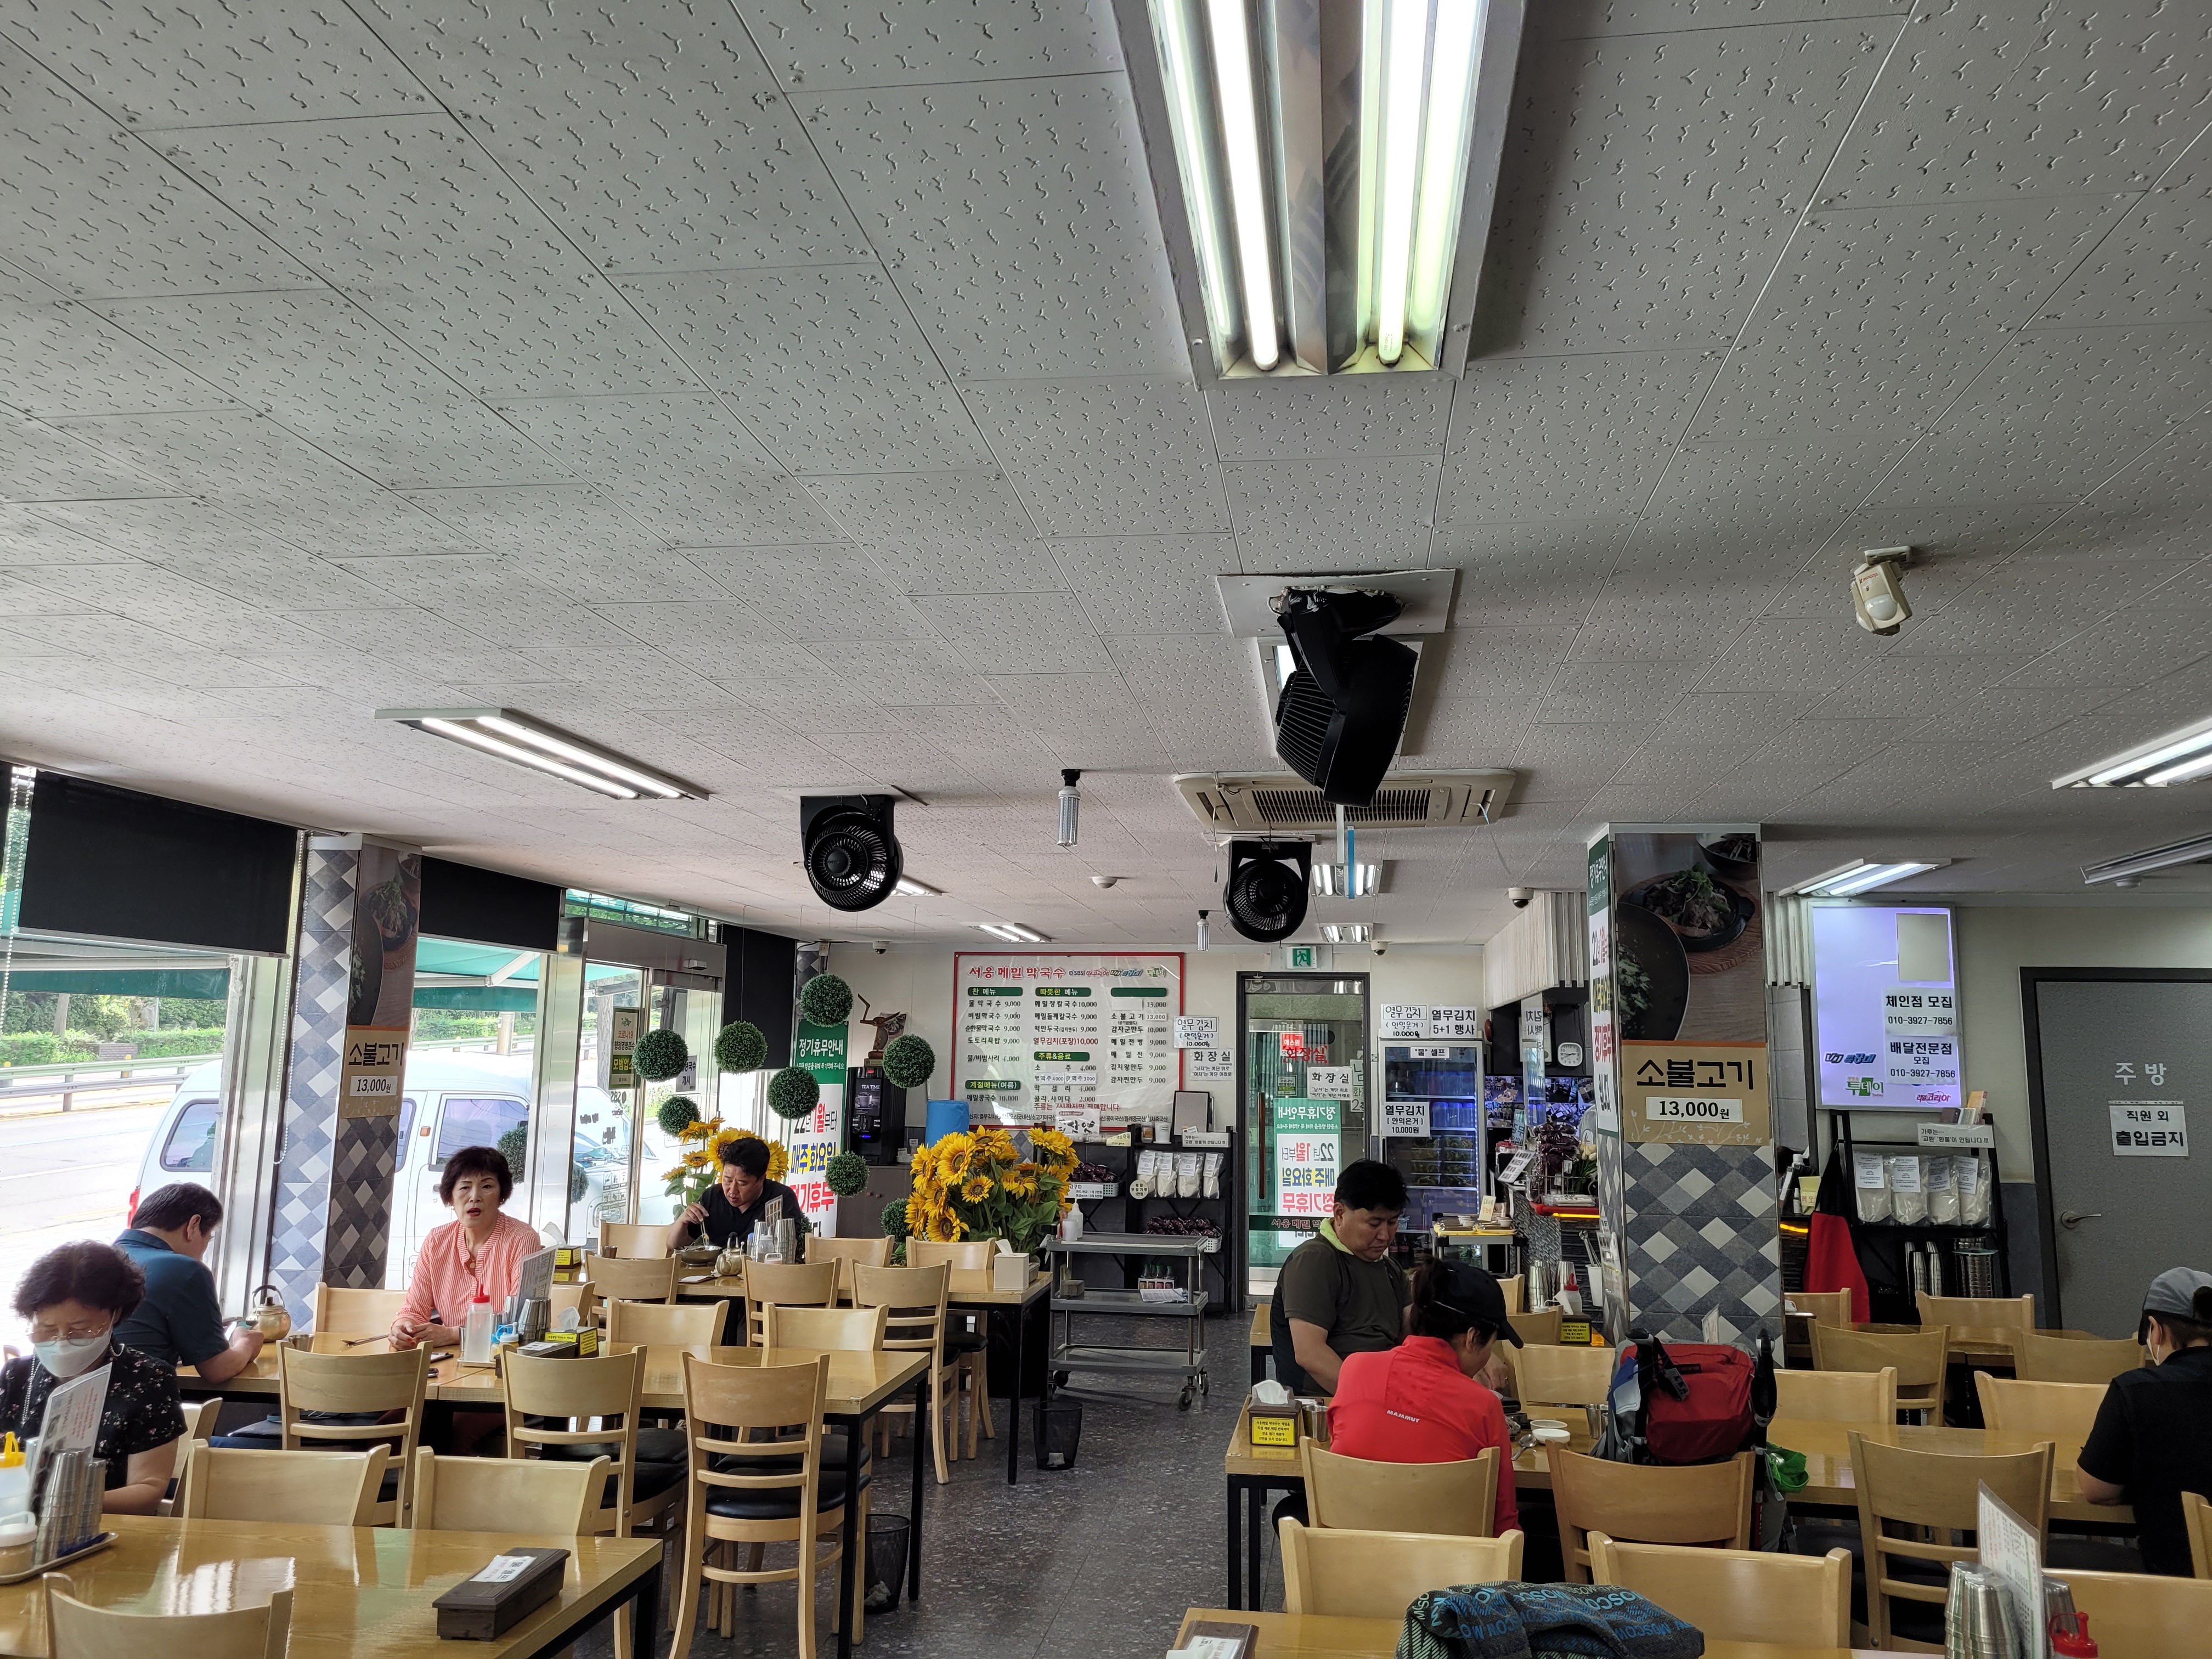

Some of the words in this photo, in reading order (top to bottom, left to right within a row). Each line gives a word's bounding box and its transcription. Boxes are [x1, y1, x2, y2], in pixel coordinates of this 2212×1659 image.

[997, 967, 1023, 979] 메밀
[1026, 967, 1065, 979] 막국수
[1886, 995, 1923, 1008] 체인점
[1928, 995, 1953, 1008] 모집
[1432, 1009, 1475, 1022] 열무김치
[1888, 1015, 1953, 1026] 010-3927-7856
[618, 1030, 634, 1039] 코로나19
[1433, 1024, 1450, 1034] 5+1
[1455, 1024, 1475, 1035] 행사
[348, 1042, 403, 1066] 소불고기
[799, 1038, 843, 1058] 정기휴무안내
[1431, 1048, 1446, 1057] 셀프
[1890, 1042, 1952, 1055] 배달전문점
[1193, 1051, 1231, 1062] 화장실
[1286, 1047, 1327, 1062] 화장실
[1844, 1053, 1876, 1064] 특공대
[1914, 1057, 1930, 1065] 모집
[1312, 1073, 1350, 1084] 화장실
[1637, 1058, 1754, 1090] 소불고기
[1891, 1069, 1955, 1078] 010-3927-7856
[356, 1078, 391, 1094] 13,000원
[682, 1075, 691, 1086] 개시
[1846, 1077, 1884, 1096] 투데이
[1385, 1105, 1425, 1116] 열무김치
[1658, 1101, 1730, 1120] 13,000원
[2126, 1110, 2152, 1122] 직원
[2157, 1110, 2169, 1122] 외
[2116, 1130, 2184, 1147] 출입금지
[790, 1144, 809, 1175] 매주
[1292, 1219, 1311, 1230] 메밀
[1386, 1410, 1420, 1424] MAMMUT
